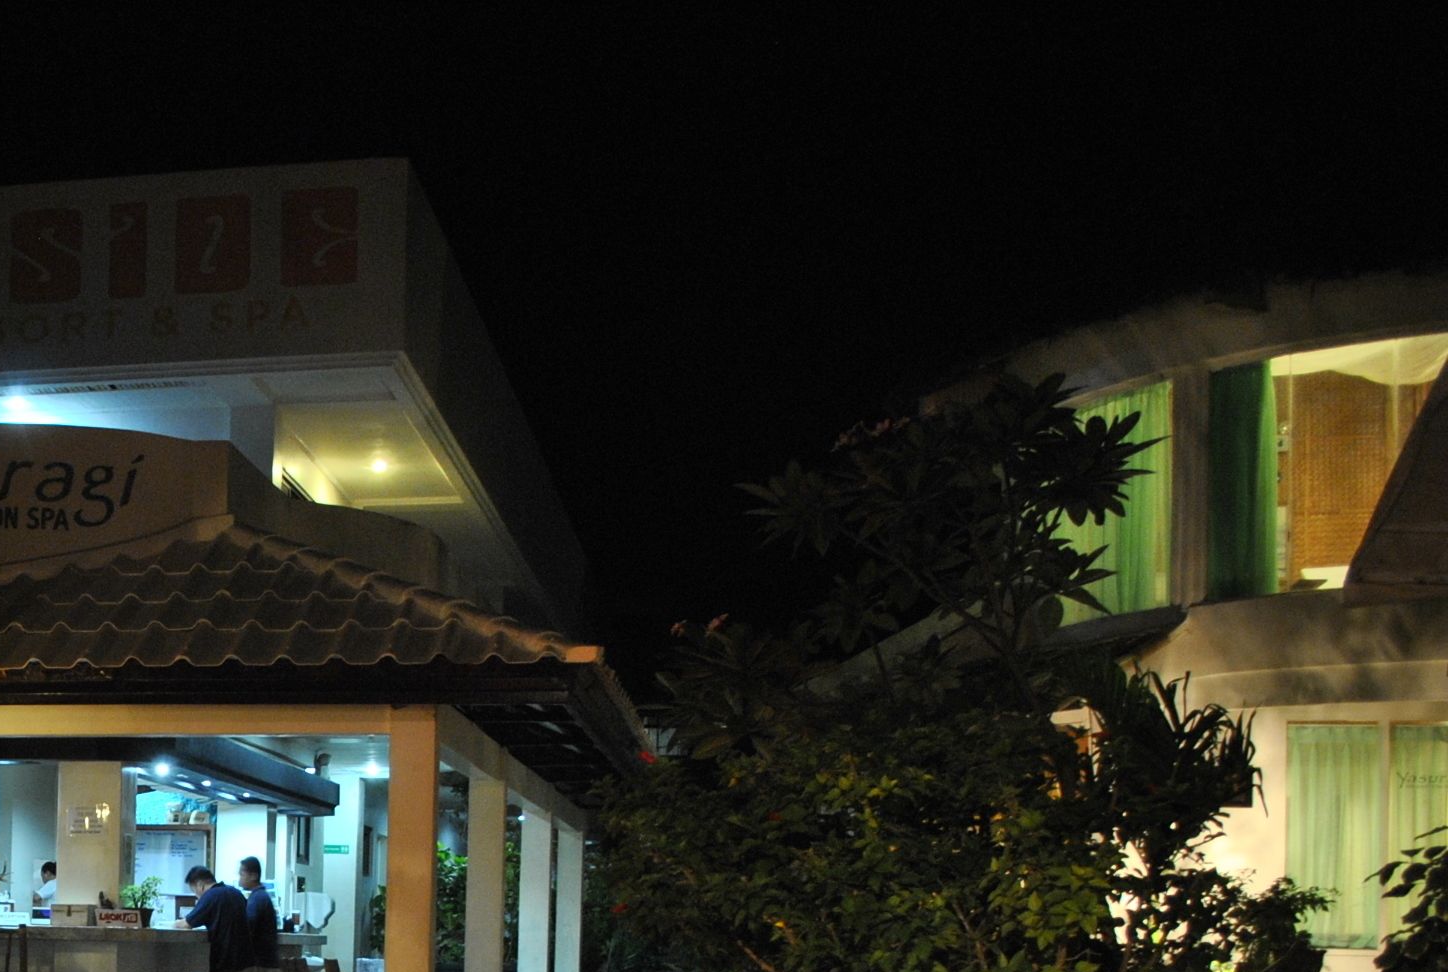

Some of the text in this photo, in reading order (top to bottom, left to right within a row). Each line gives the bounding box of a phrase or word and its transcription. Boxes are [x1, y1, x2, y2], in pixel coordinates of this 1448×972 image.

[151, 304, 181, 337] &
[208, 296, 310, 331] SPA
[26, 508, 69, 530] SPA
[1396, 770, 1448, 788] Yasur
